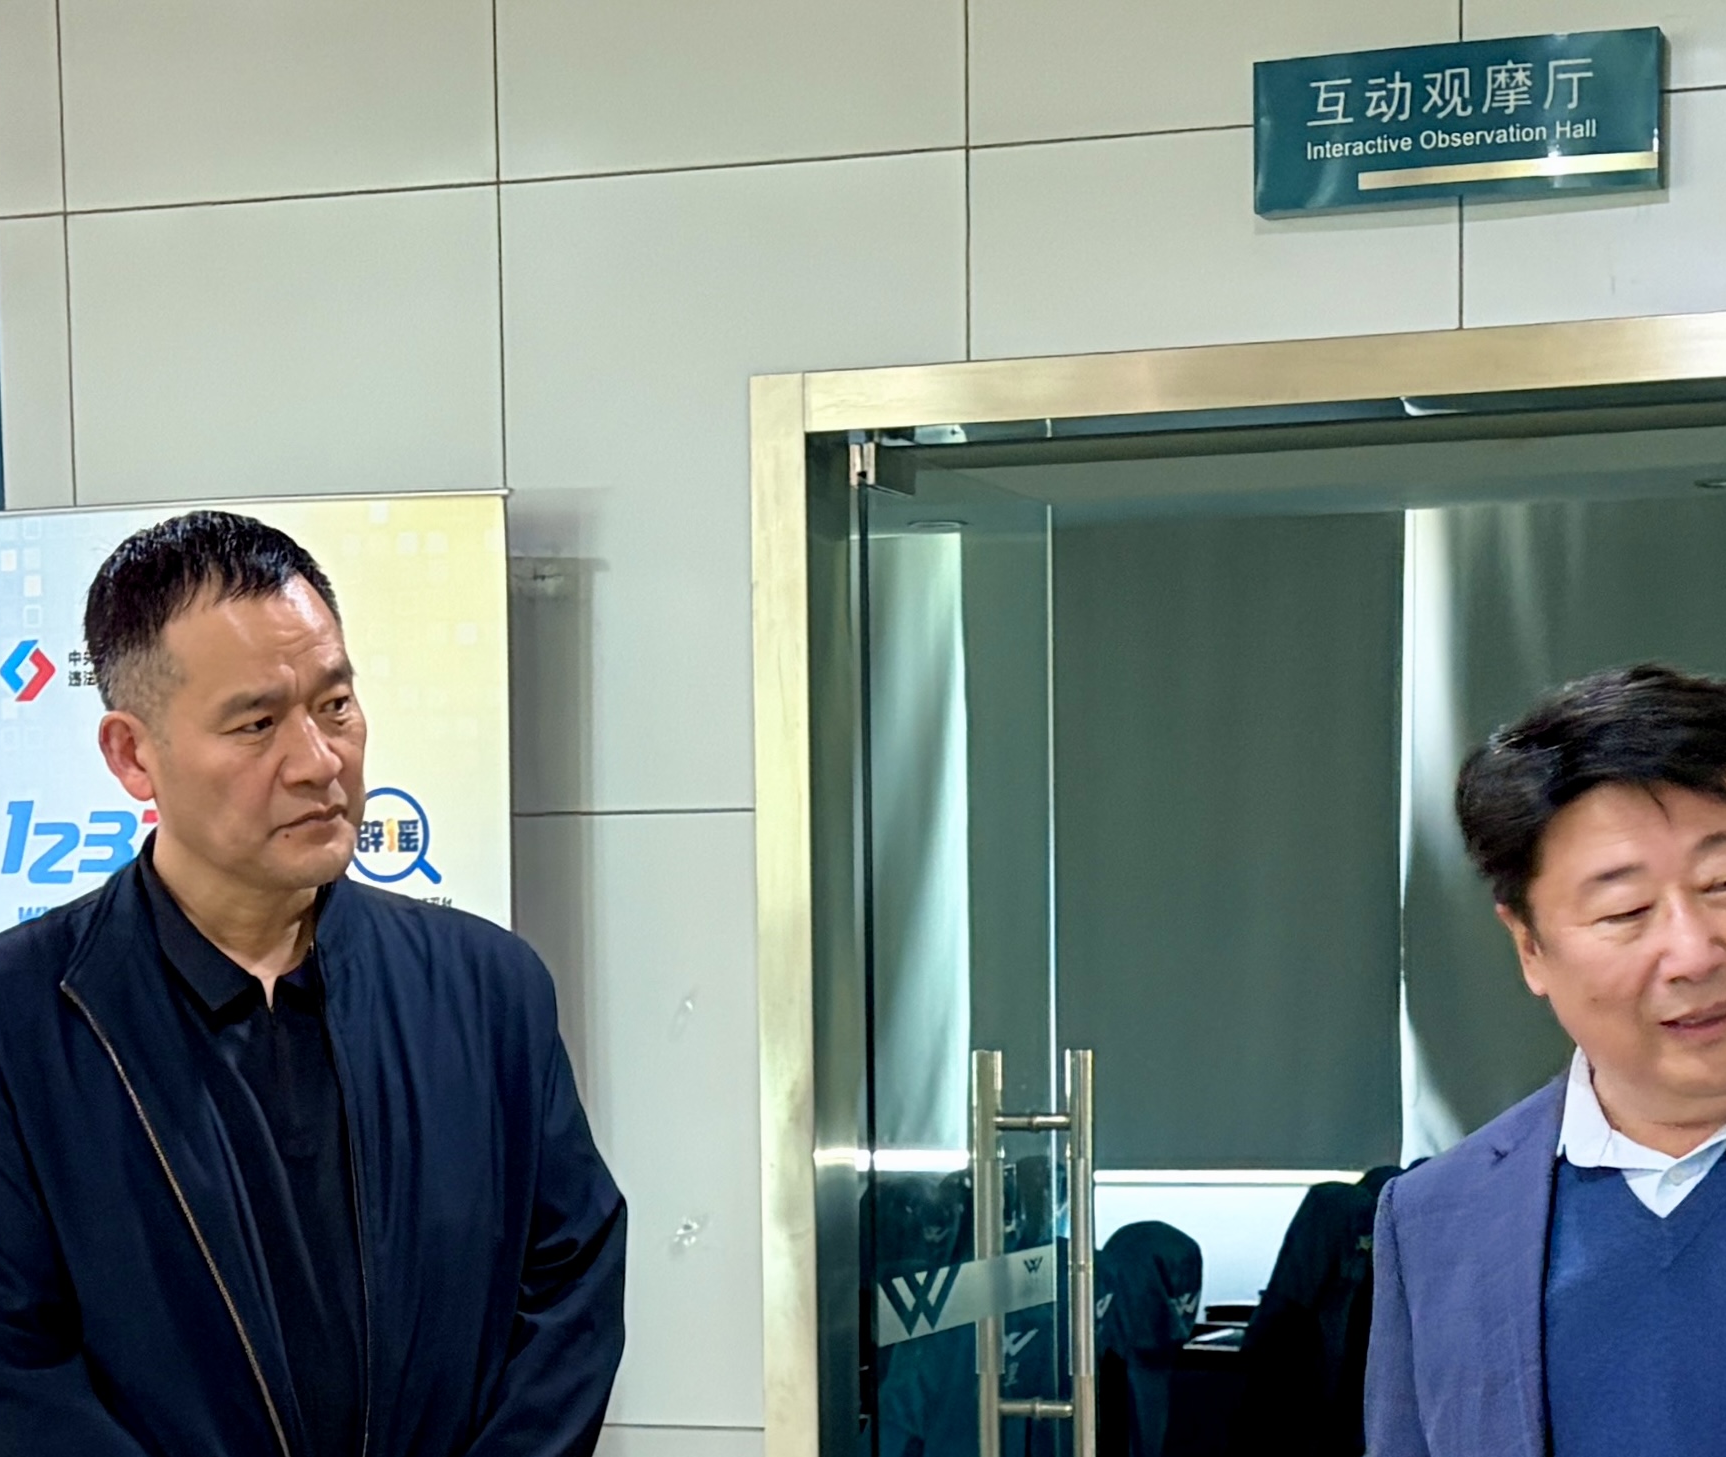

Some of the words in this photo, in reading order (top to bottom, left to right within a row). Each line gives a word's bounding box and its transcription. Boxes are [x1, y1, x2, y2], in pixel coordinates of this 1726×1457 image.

[1307, 57, 1594, 127] 互动观摩厅
[1306, 134, 1413, 161] Interactive
[1419, 123, 1547, 151] Observation
[1554, 119, 1598, 140] Hall
[1, 800, 158, 884] 123
